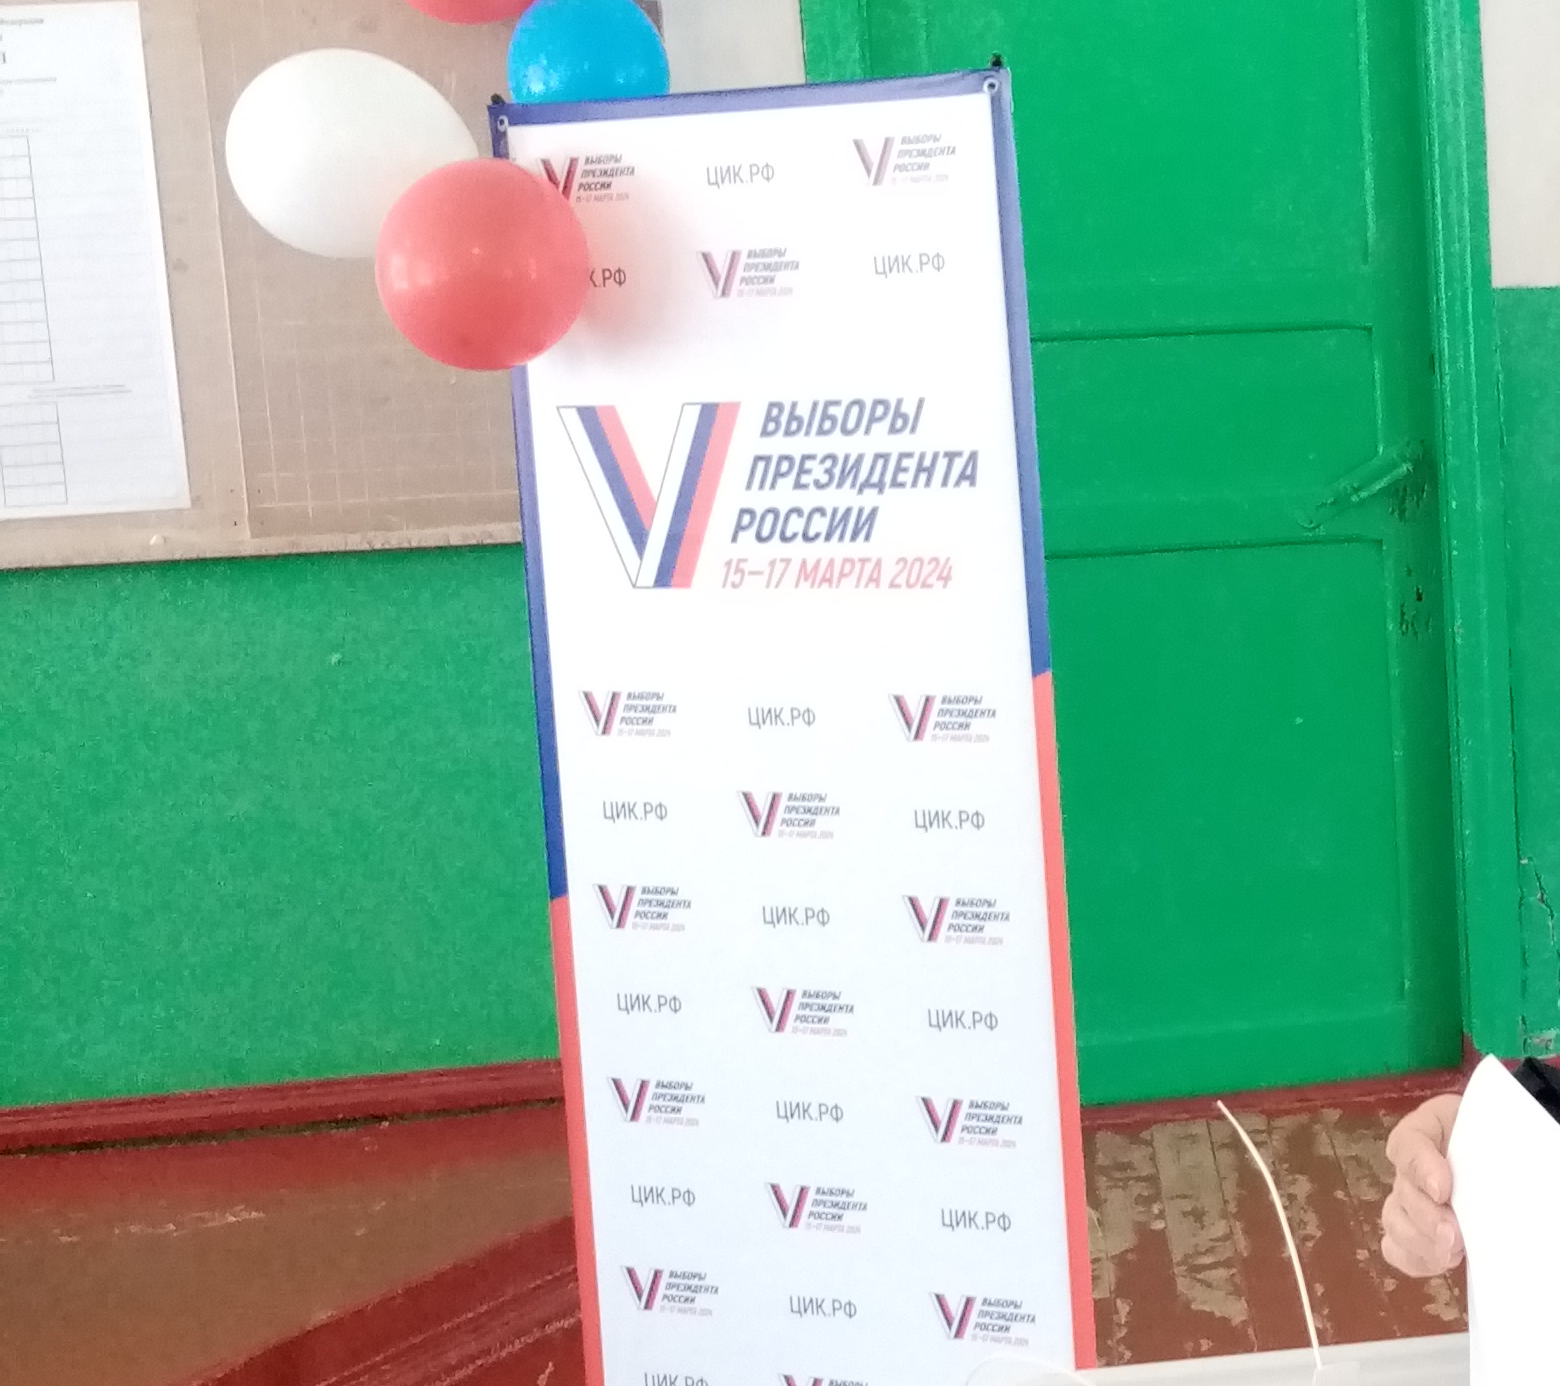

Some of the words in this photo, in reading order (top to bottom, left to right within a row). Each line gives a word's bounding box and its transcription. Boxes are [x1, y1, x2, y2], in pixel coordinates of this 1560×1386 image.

[707, 163, 774, 189] ЦИК.РФ
[874, 252, 944, 278] ЦИК.РФ
[759, 397, 925, 439] ВЫБОРЫ
[745, 450, 979, 496] ПРЕЗИДЕНТА
[730, 505, 879, 544] РОССИИ
[794, 557, 883, 590] МАРТА
[888, 556, 953, 590] 2024
[748, 707, 815, 729] ЦИК.РФ
[603, 801, 667, 823] ЦИК.РФ
[914, 810, 985, 833] ЦИК.РФ
[763, 906, 830, 928] ЦИК.РФ
[617, 993, 681, 1015] ЦИК.РФ
[928, 1009, 998, 1032] ЦИК.РФ
[776, 1101, 843, 1123] ЦИК.РФ
[631, 1185, 695, 1207] ЦИК.РФ
[941, 1209, 1011, 1232] ЦИК.РФ
[790, 1296, 857, 1319] ЦИК.РФ
